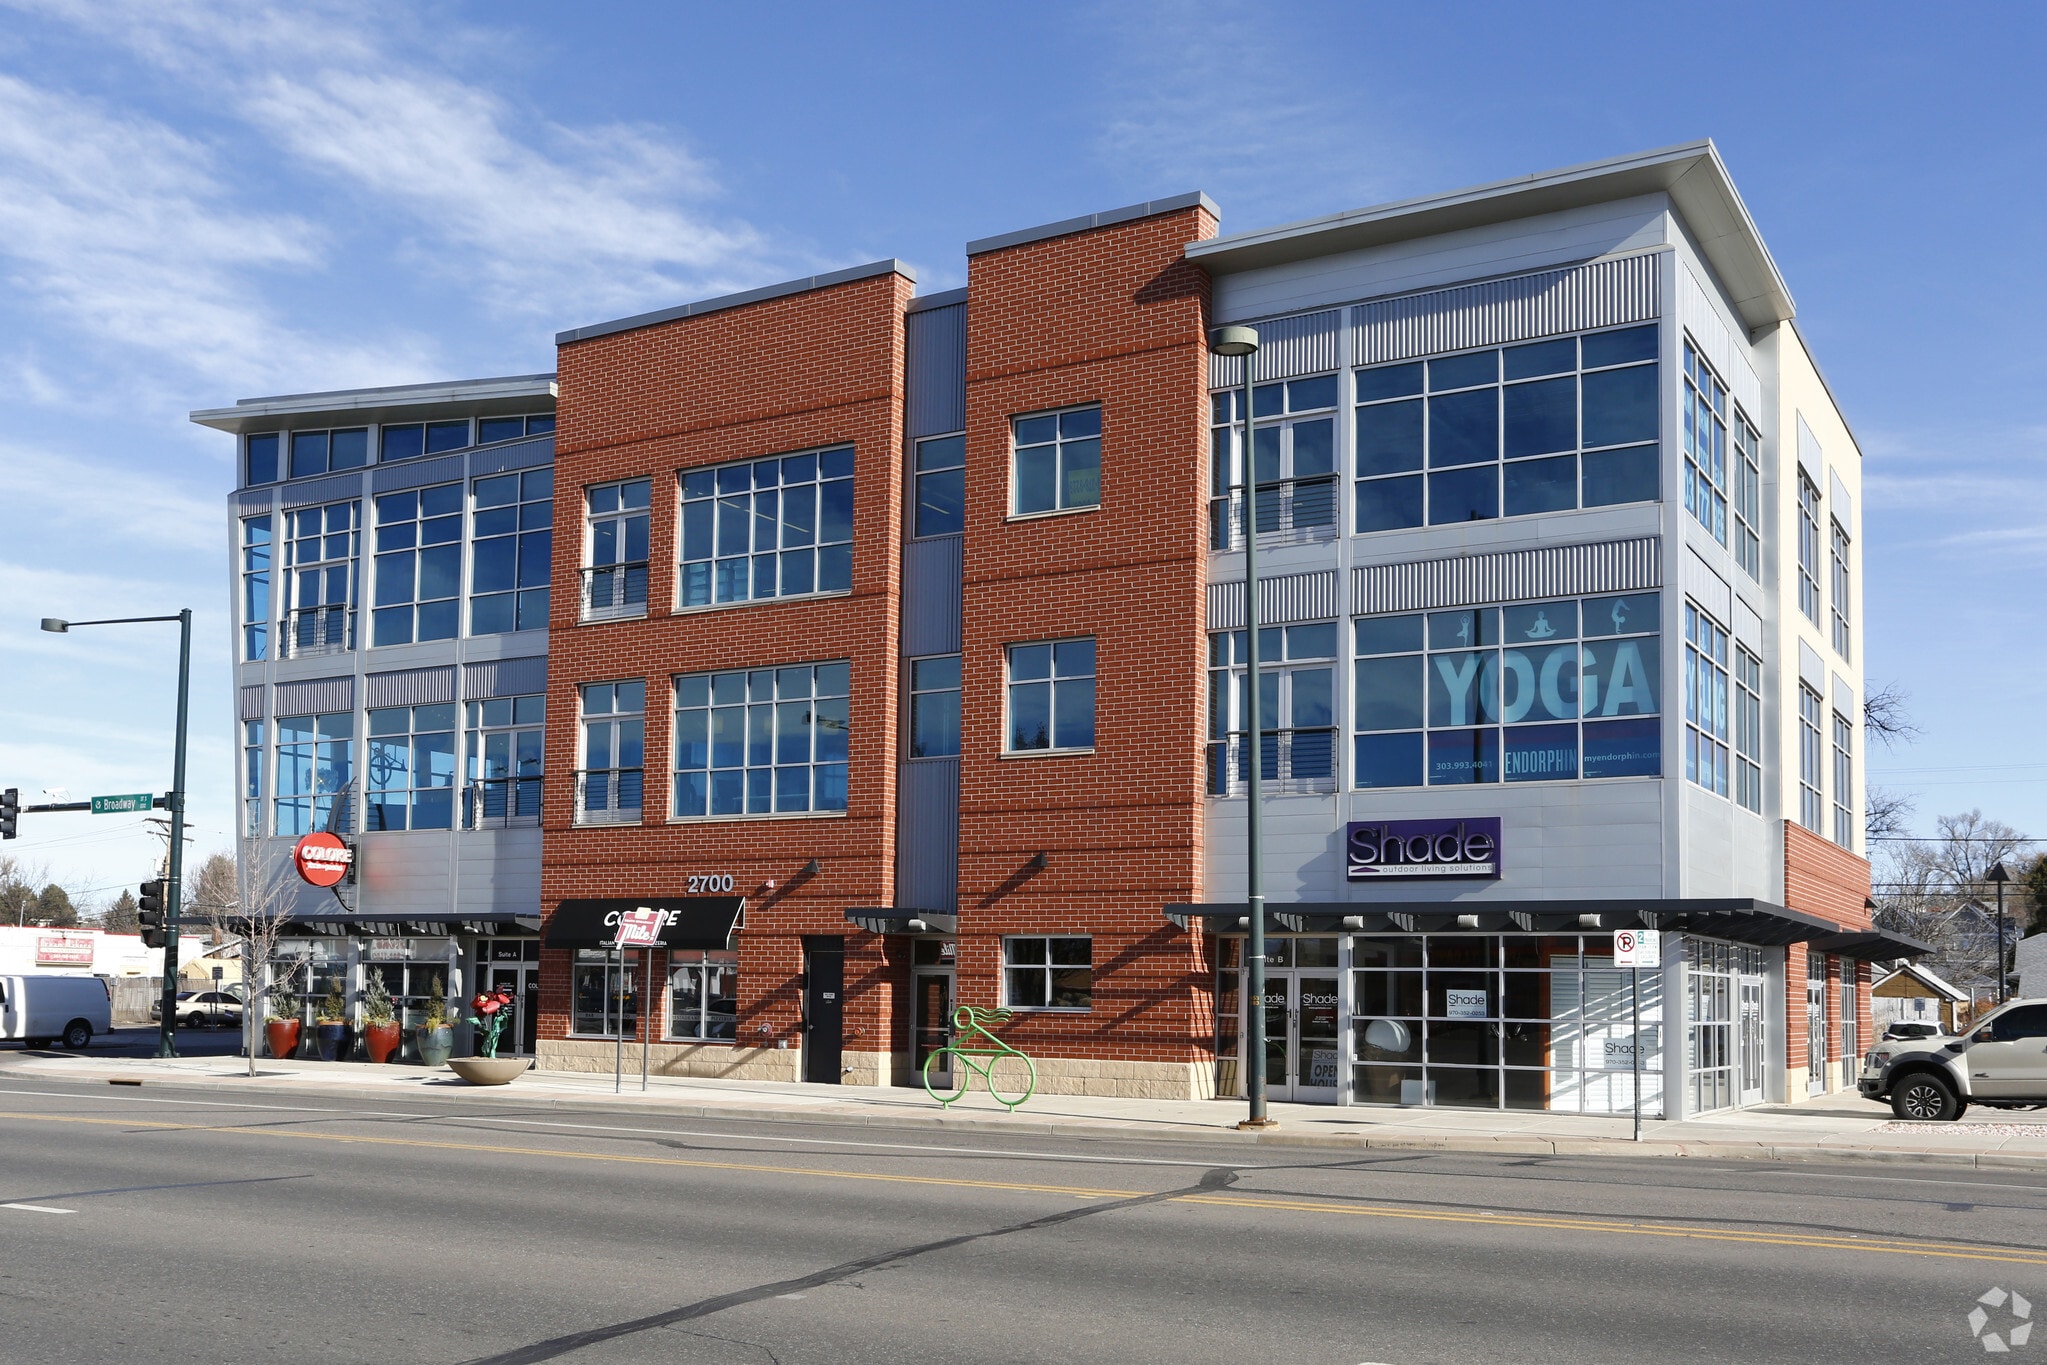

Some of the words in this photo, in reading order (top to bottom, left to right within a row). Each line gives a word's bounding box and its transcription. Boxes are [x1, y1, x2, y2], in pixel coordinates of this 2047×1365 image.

[1433, 641, 1656, 726] YOGA
[1436, 759, 1494, 771] 303.993.4041
[1504, 749, 1577, 774] ENDORPHIN
[1584, 751, 1661, 764] myendorphin.com
[103, 798, 136, 812] Broadway
[1350, 822, 1495, 864] Shade
[1382, 864, 1418, 873] outdoor
[1421, 864, 1446, 874] living
[1449, 864, 1492, 873] solutions
[687, 874, 734, 893] 2700
[1277, 955, 1284, 963] B
[1264, 993, 1285, 1004] ade
[1302, 993, 1338, 1004] Shade
[1448, 994, 1485, 1006] Shade
